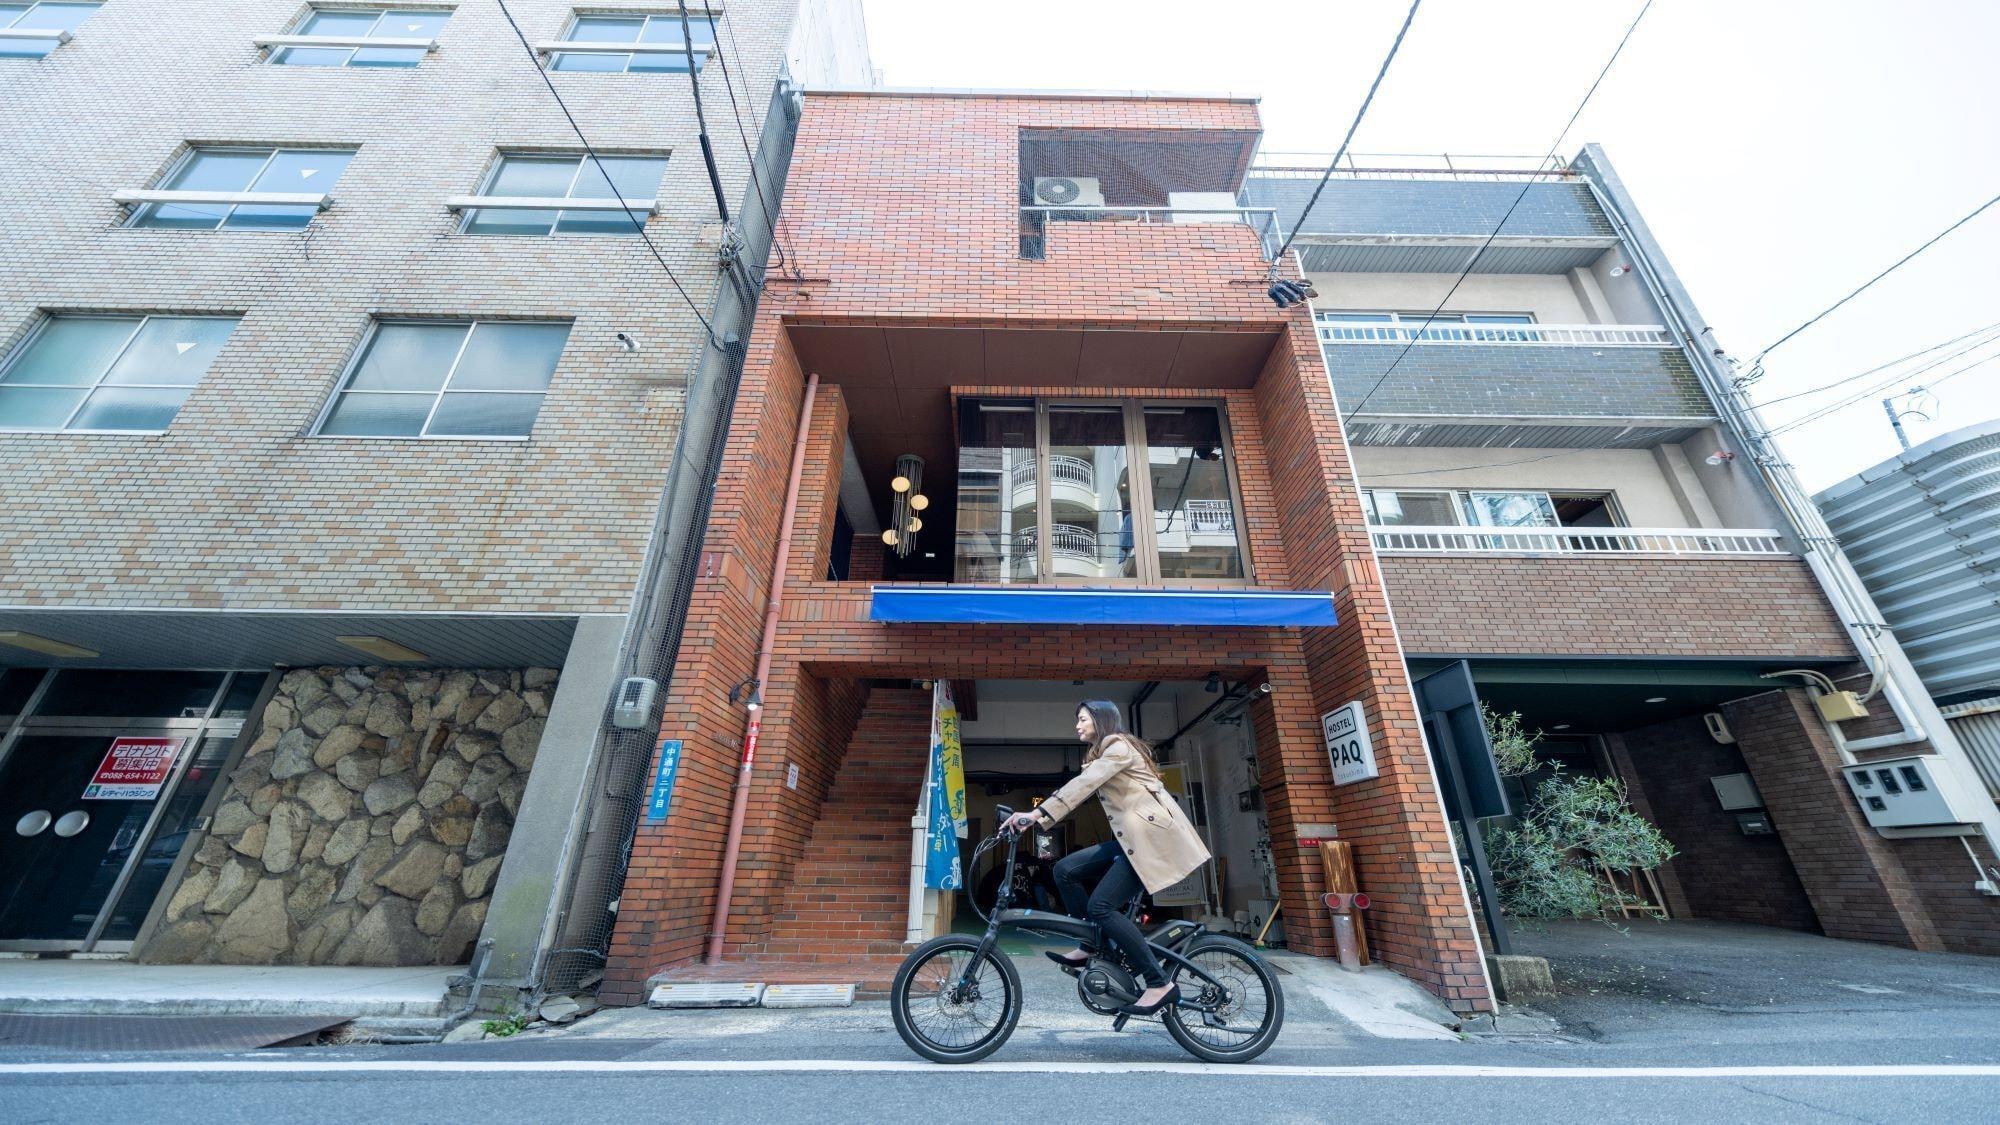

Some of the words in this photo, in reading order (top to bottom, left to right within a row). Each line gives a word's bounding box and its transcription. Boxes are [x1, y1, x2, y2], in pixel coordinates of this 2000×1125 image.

[1328, 717, 1352, 735] HOSTEL
[114, 745, 172, 757] テナント
[1331, 740, 1364, 768] PAQ
[113, 758, 161, 770] 募集中
[109, 772, 161, 780] 088-654-1122
[655, 747, 676, 808] 中通町二丁目
